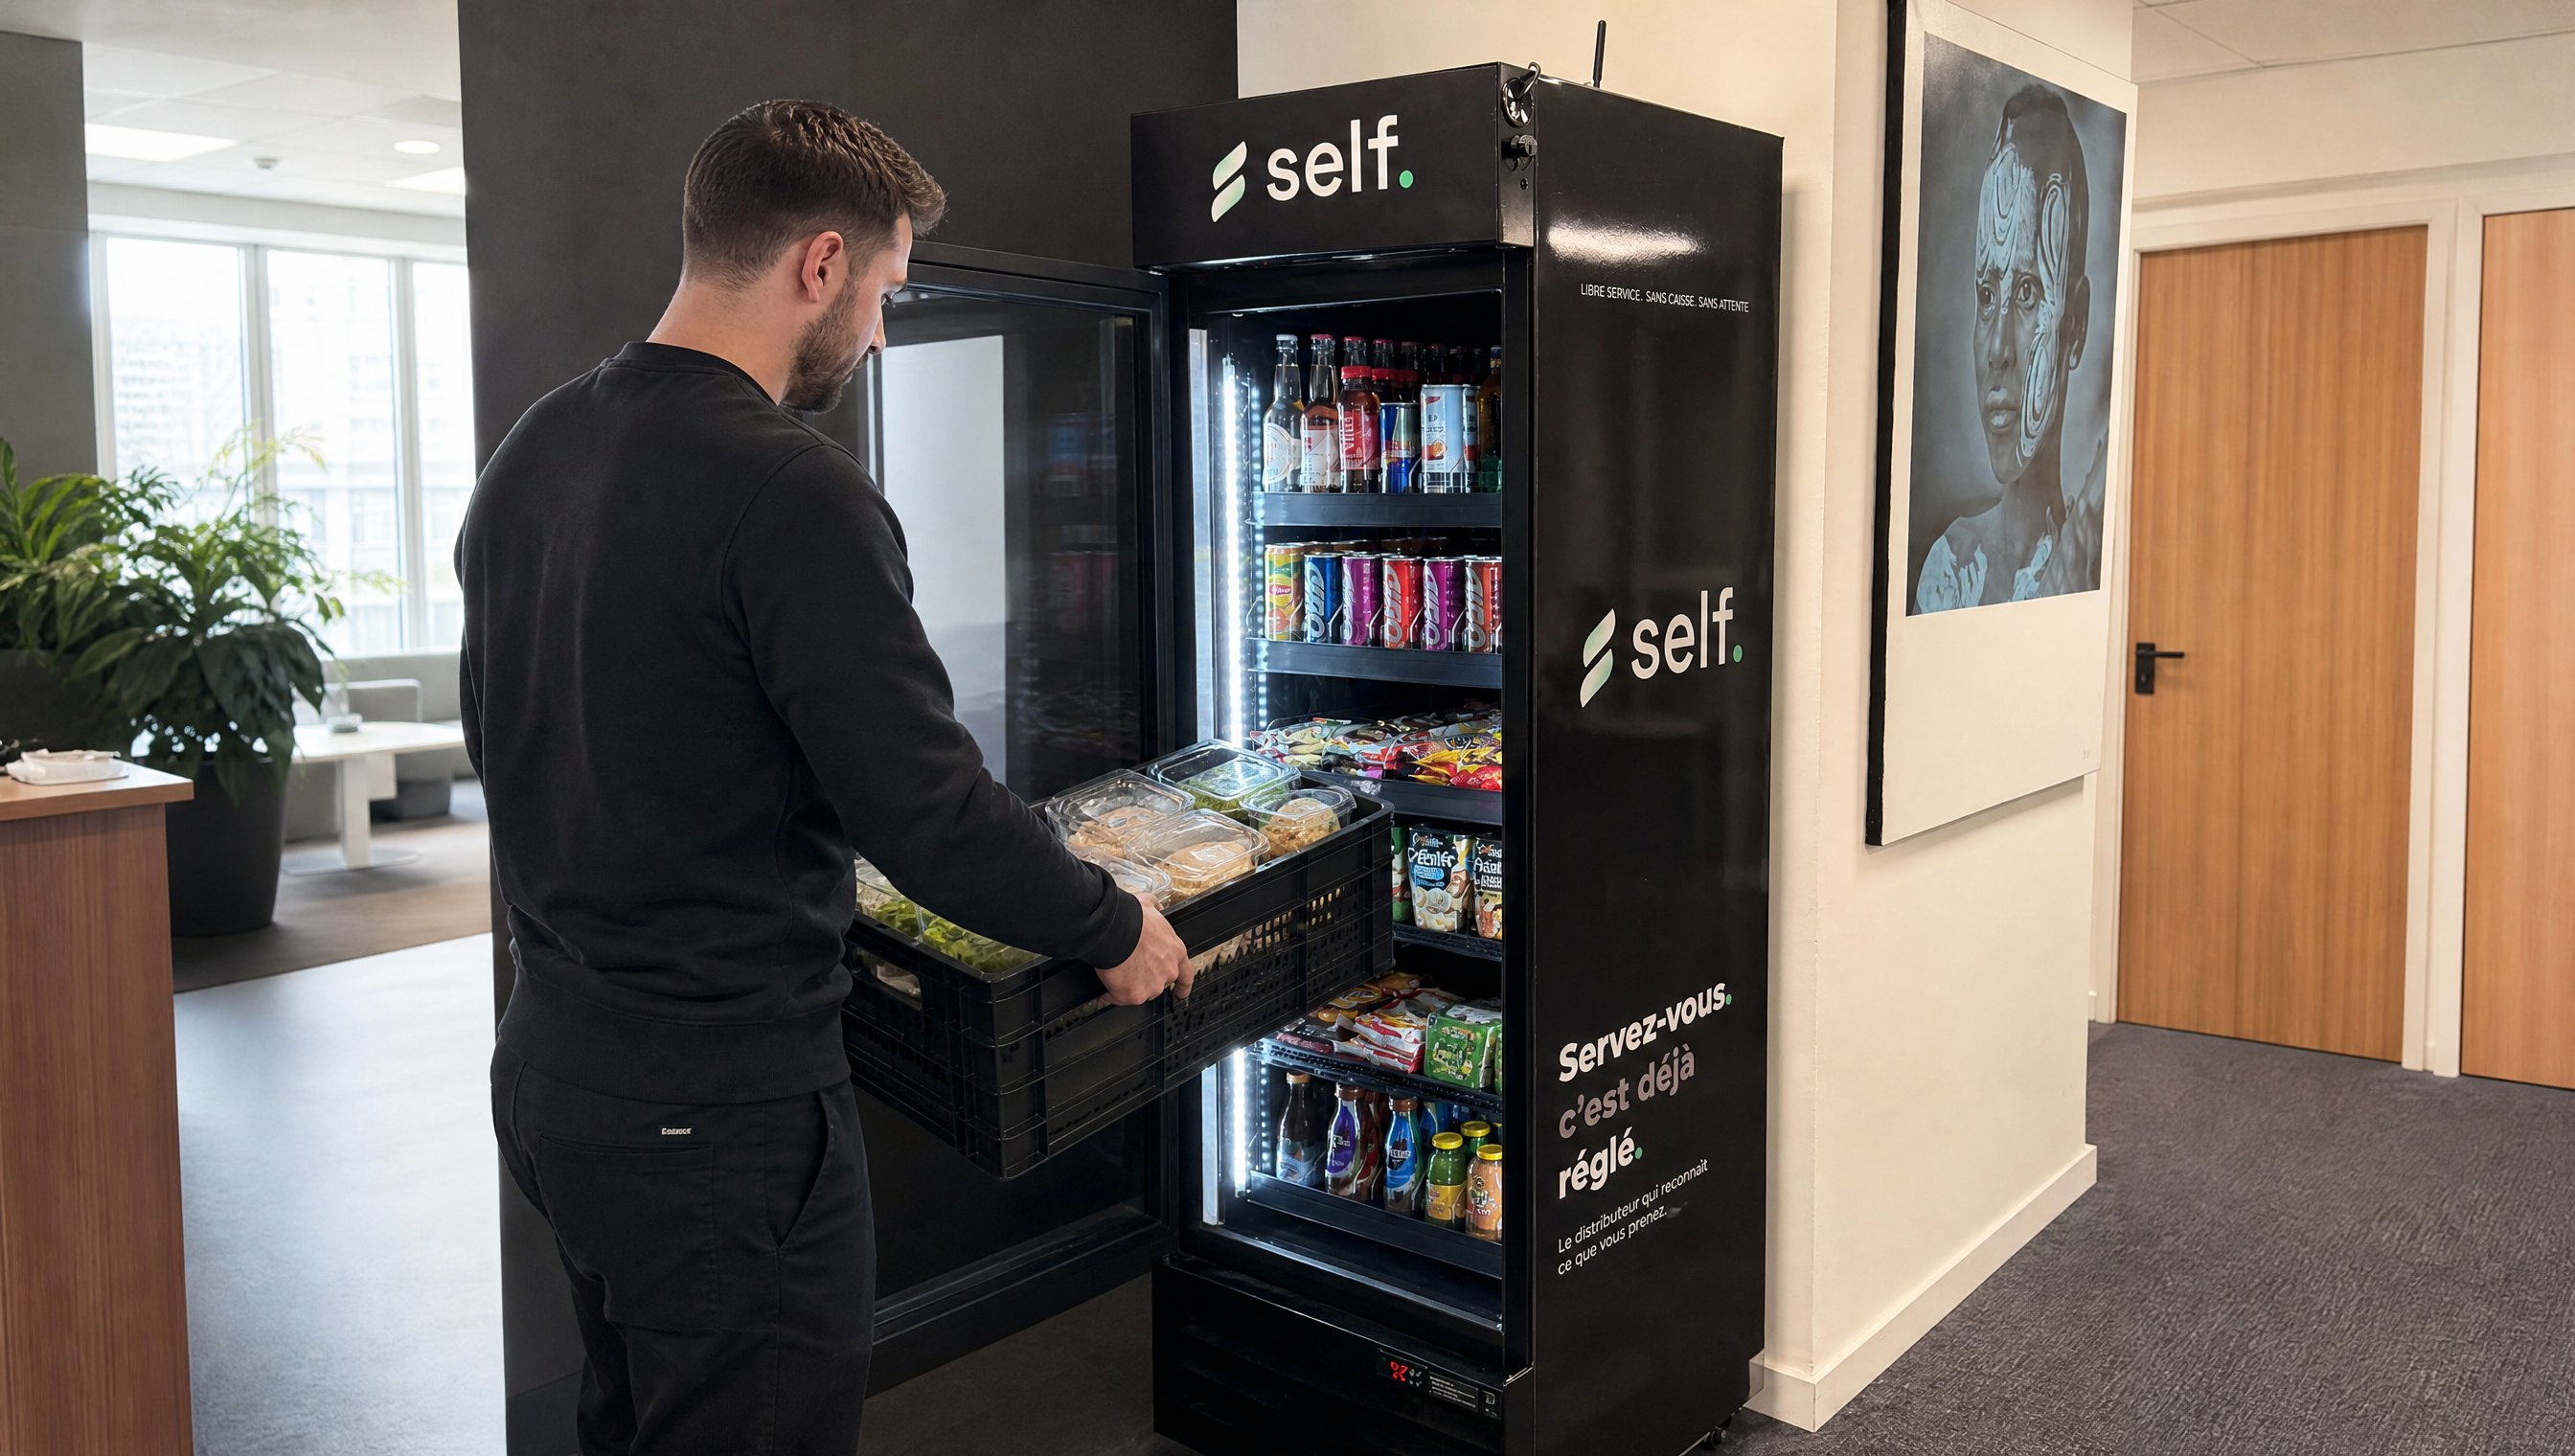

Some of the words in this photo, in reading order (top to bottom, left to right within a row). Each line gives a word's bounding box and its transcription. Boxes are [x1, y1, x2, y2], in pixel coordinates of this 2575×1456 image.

[1266, 114, 1414, 201] self.
[1581, 284, 1605, 297] LIBRE
[1607, 286, 1643, 302] SERVICE.
[1646, 290, 1667, 304] SANS
[1668, 293, 1697, 307] CAISSE.
[1698, 296, 1718, 309] SANS
[1719, 299, 1749, 312] ATTENTE
[1631, 586, 1743, 679] self.
[1559, 982, 1732, 1082] Servez-vous.
[1559, 1078, 1629, 1139] c’est
[1637, 1043, 1696, 1102] déjà
[1558, 1235, 1572, 1254] Le
[1575, 1197, 1640, 1245] distributeur
[1641, 1185, 1659, 1207] qui
[1661, 1158, 1708, 1194] reconnait
[1559, 1126, 1643, 1199] réglé.
[1558, 1258, 1572, 1276] ce
[1575, 1244, 1597, 1267] que
[1599, 1228, 1626, 1251] vous
[1628, 1205, 1668, 1239] prenez.
